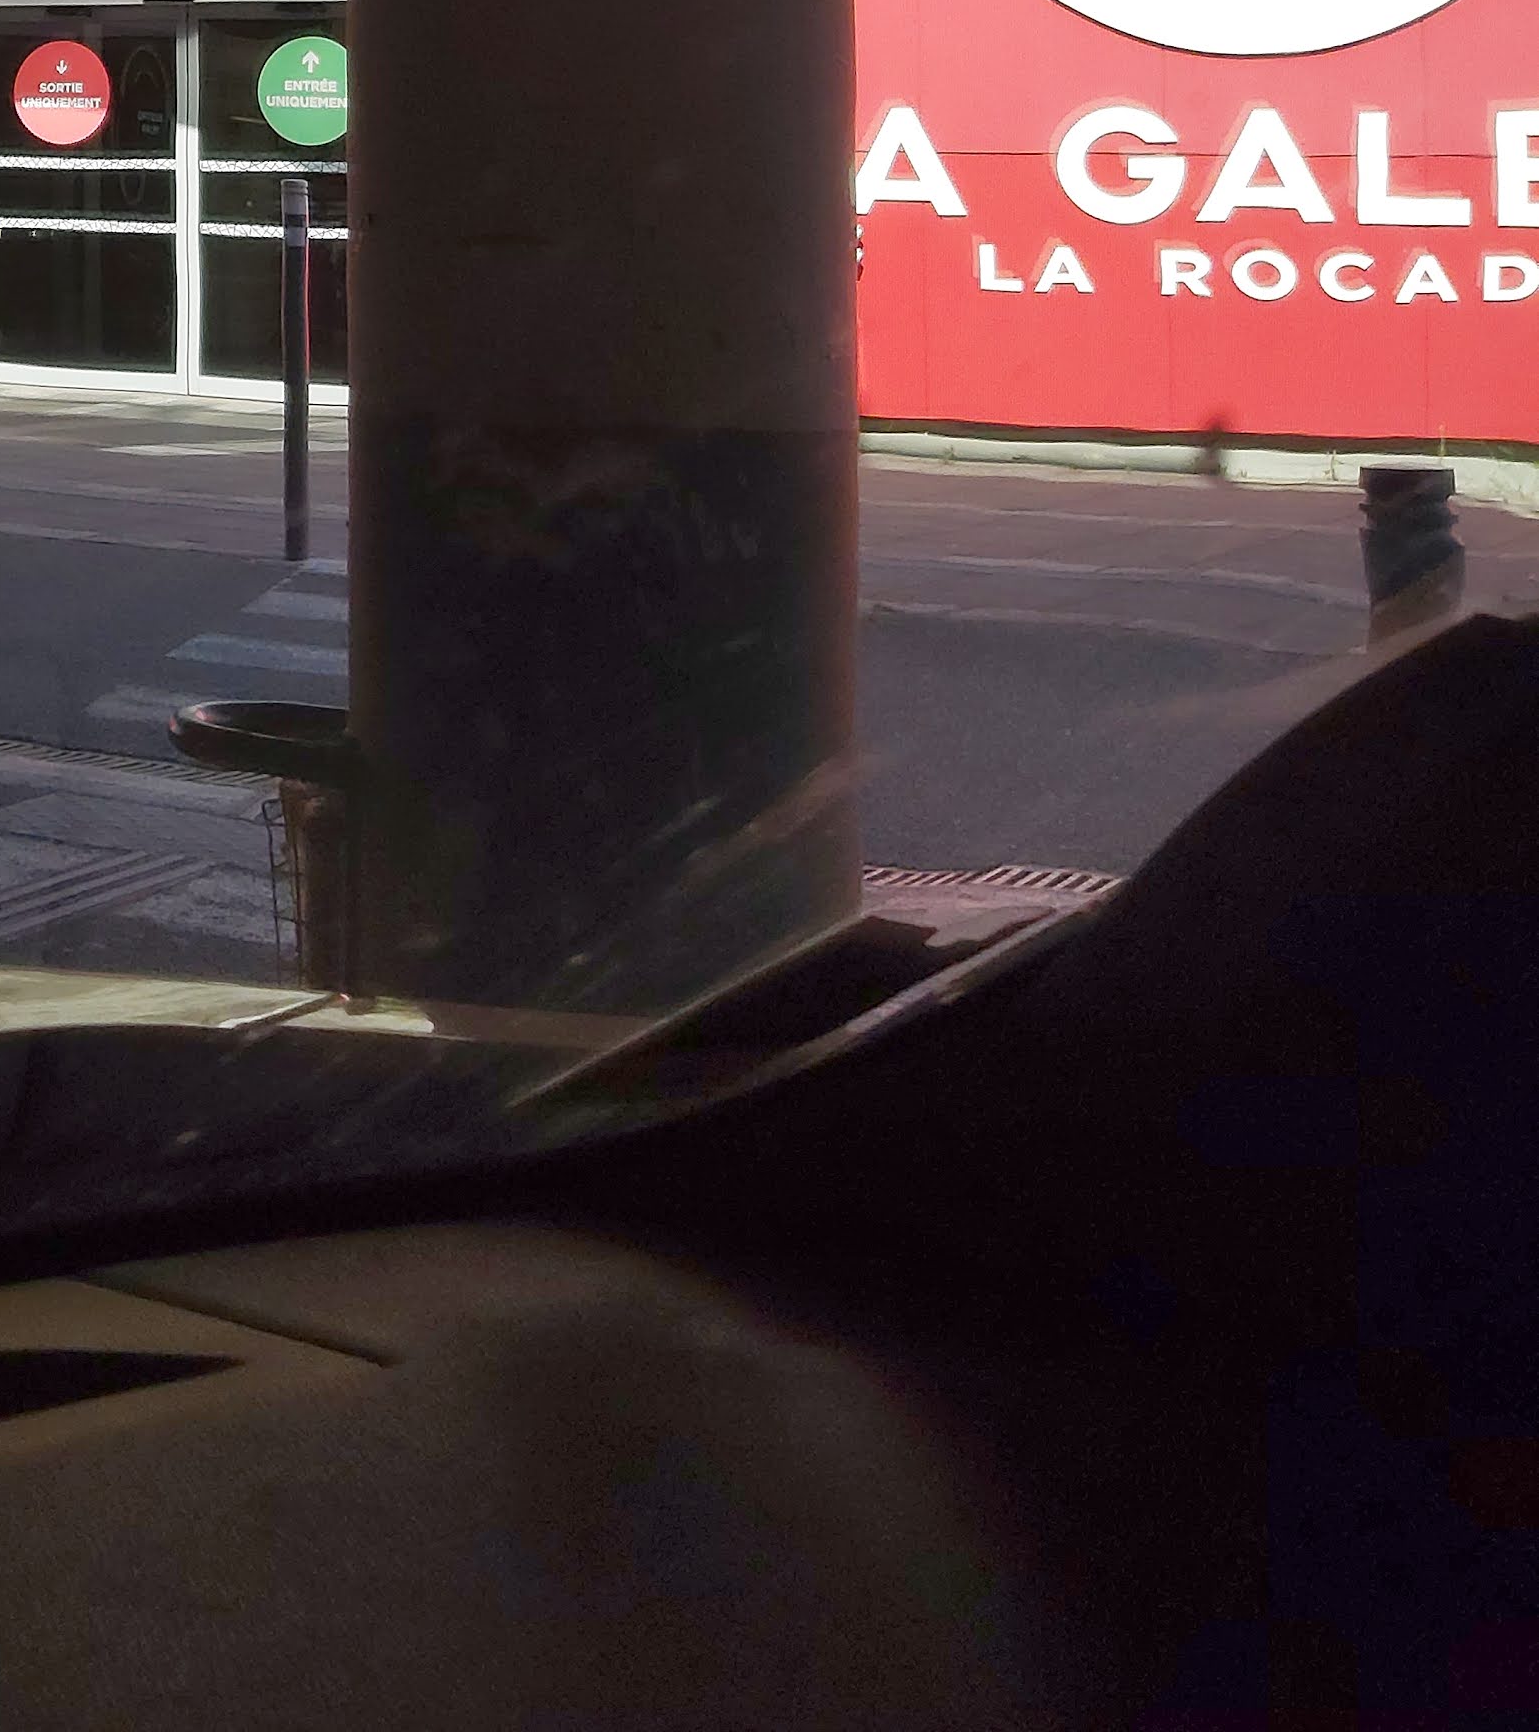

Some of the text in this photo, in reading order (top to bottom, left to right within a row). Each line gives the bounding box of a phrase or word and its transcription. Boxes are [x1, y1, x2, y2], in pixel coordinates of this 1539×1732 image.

[38, 82, 83, 93] SORTIE
[284, 78, 337, 92] ENTRÉE
[21, 97, 101, 108] UNIQUEMENT
[266, 96, 348, 108] UNIQUEMEN
[855, 106, 968, 217] A
[978, 243, 1539, 304] LA ROCAD
